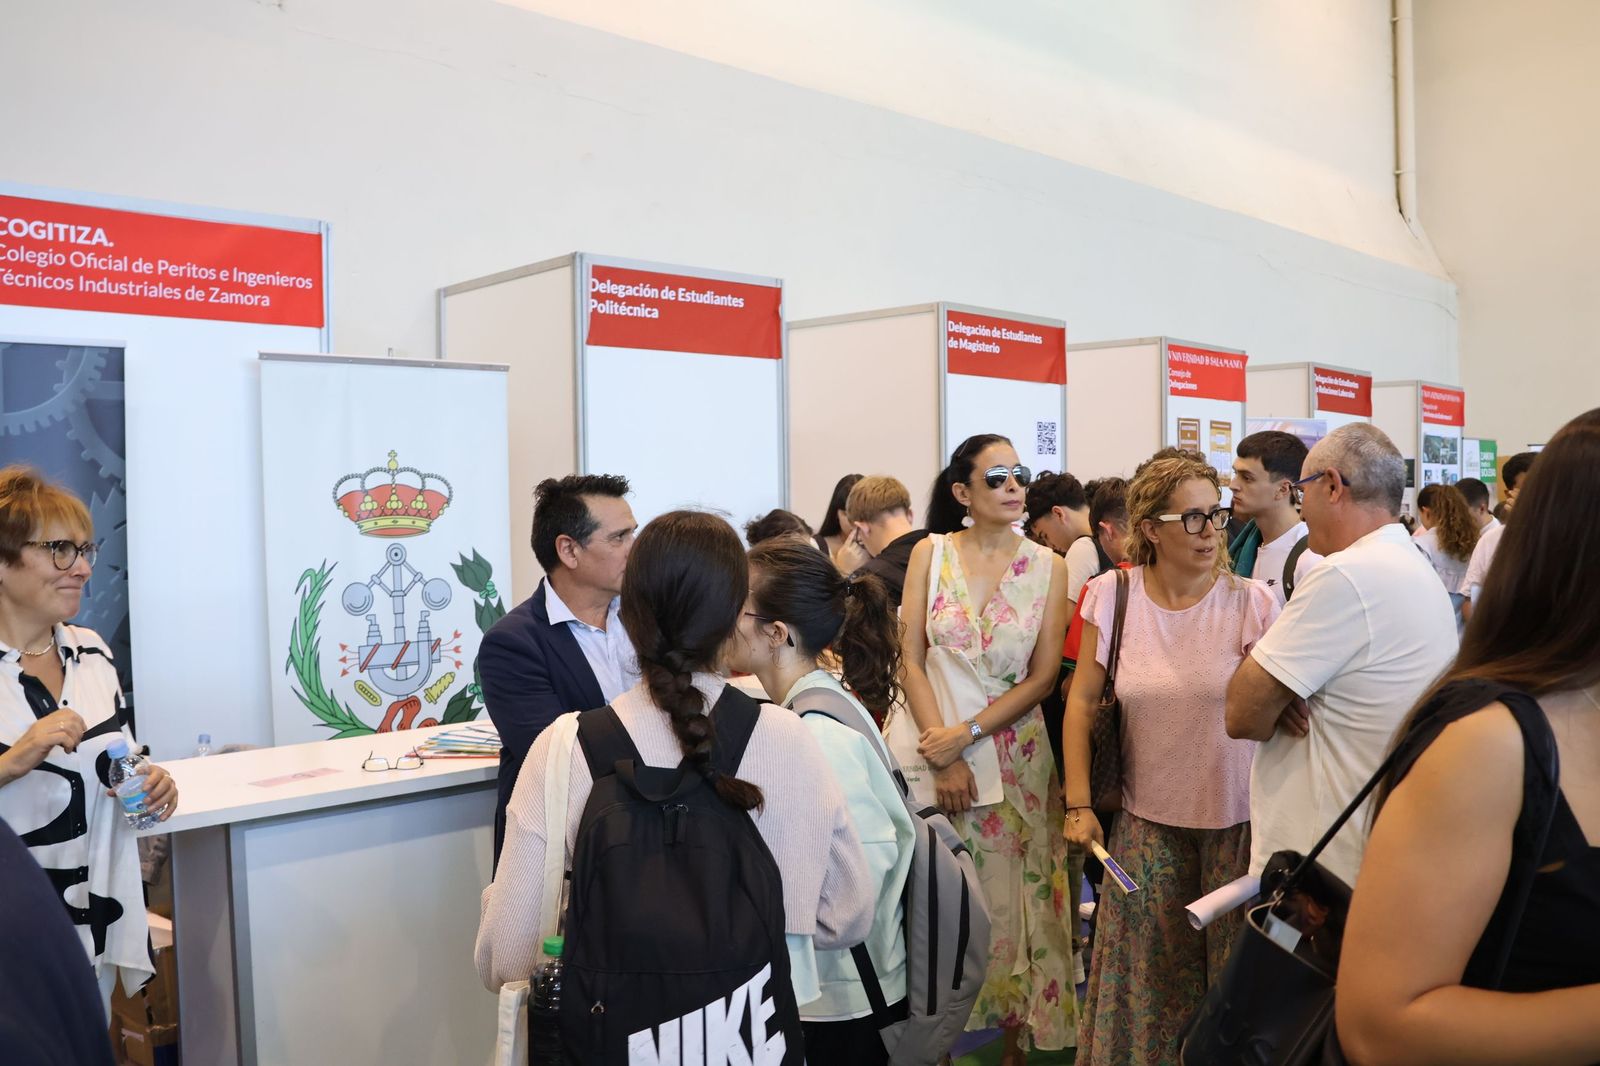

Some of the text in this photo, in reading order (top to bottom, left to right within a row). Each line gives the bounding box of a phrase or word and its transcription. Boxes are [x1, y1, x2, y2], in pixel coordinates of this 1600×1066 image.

[70, 250, 128, 272] Oficial
[132, 257, 154, 274] de
[158, 260, 216, 281] Peritos
[219, 267, 229, 281] e
[233, 267, 313, 289] Ingenieros
[79, 275, 182, 299] Industriales
[185, 284, 205, 302] de
[209, 287, 270, 306] Zamora
[591, 278, 744, 308] Delegación de Estudiantes
[590, 299, 659, 319] Politécnica
[948, 321, 1043, 344] Delegación de Estudiantes
[948, 337, 1000, 353] de Magisterio
[628, 961, 787, 1066] NIKE
